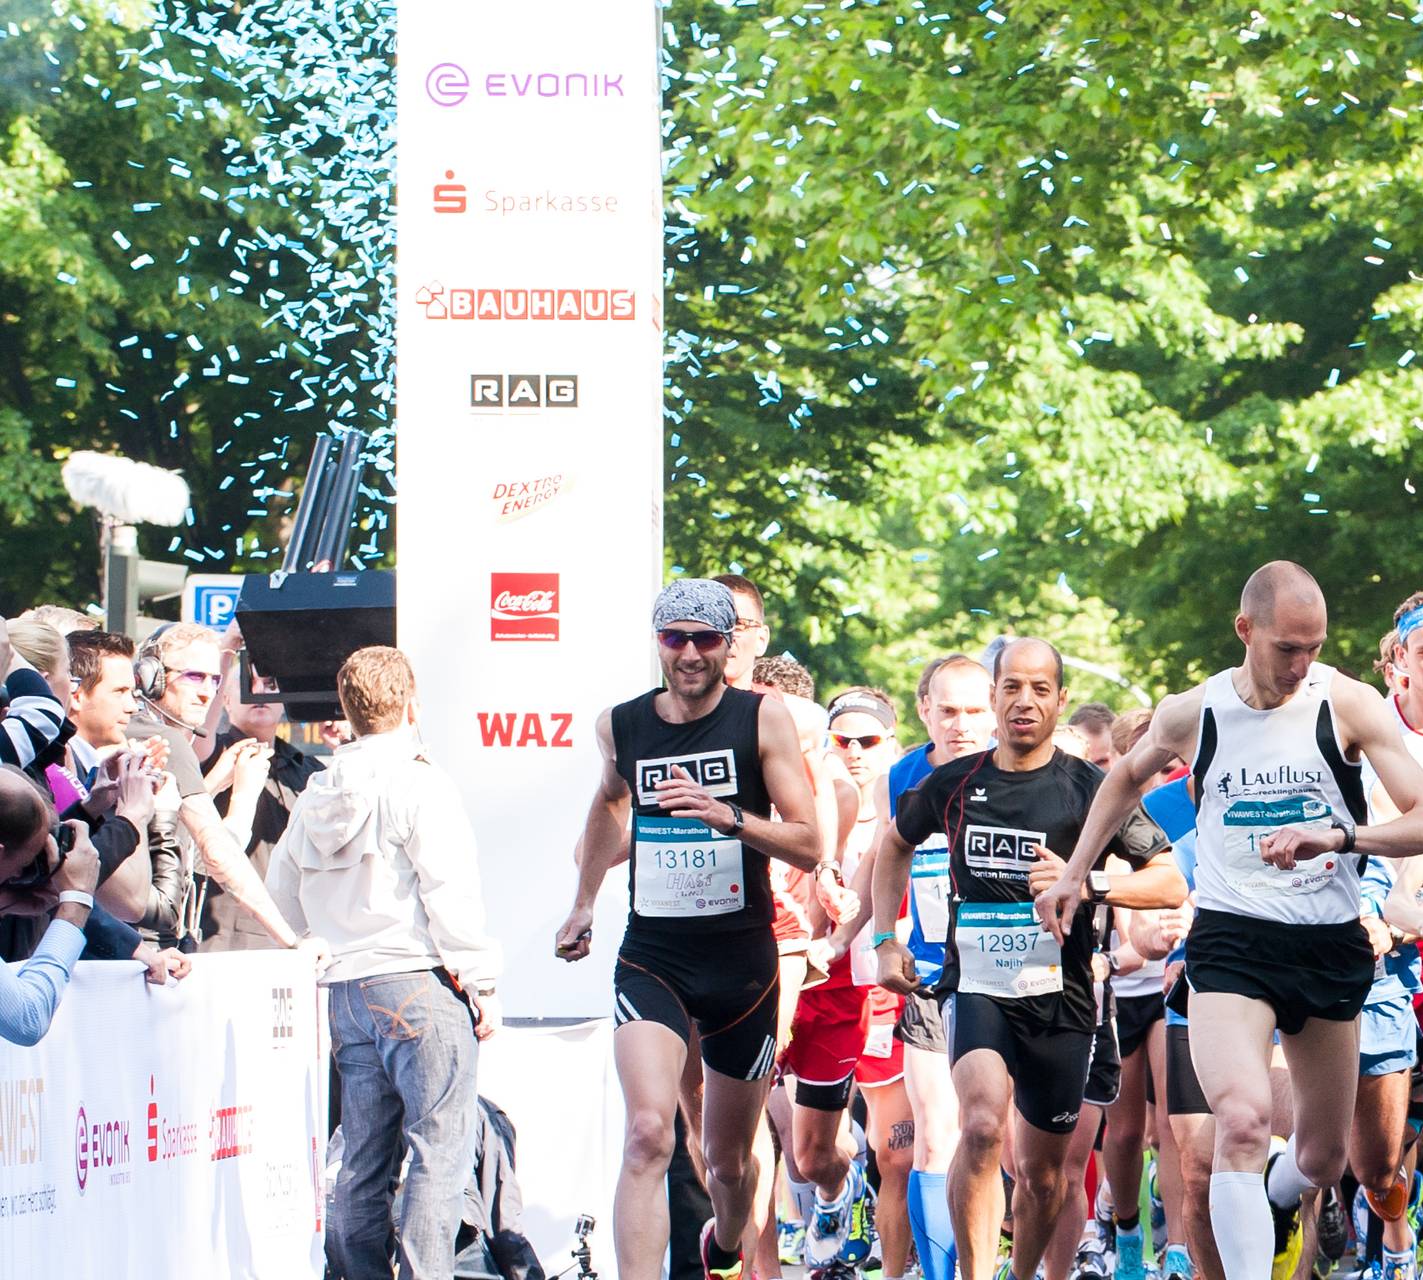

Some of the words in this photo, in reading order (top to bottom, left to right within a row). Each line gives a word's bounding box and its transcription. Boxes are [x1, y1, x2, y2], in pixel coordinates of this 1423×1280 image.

[485, 73, 624, 97] EVONIK
[485, 190, 618, 216] Sparkasse
[451, 290, 634, 319] BAUHAUS
[472, 377, 577, 406] RAG
[492, 474, 562, 499] DEXTRO
[501, 486, 560, 515] ENERGY
[210, 595, 233, 625] P
[477, 713, 573, 747] WAZ
[654, 849, 718, 868] 13181
[971, 836, 1037, 857] RAG
[708, 897, 739, 906] EVONIK
[977, 932, 1039, 952] 12937
[995, 959, 1023, 969] Najih
[93, 1120, 130, 1168] EVONIK
